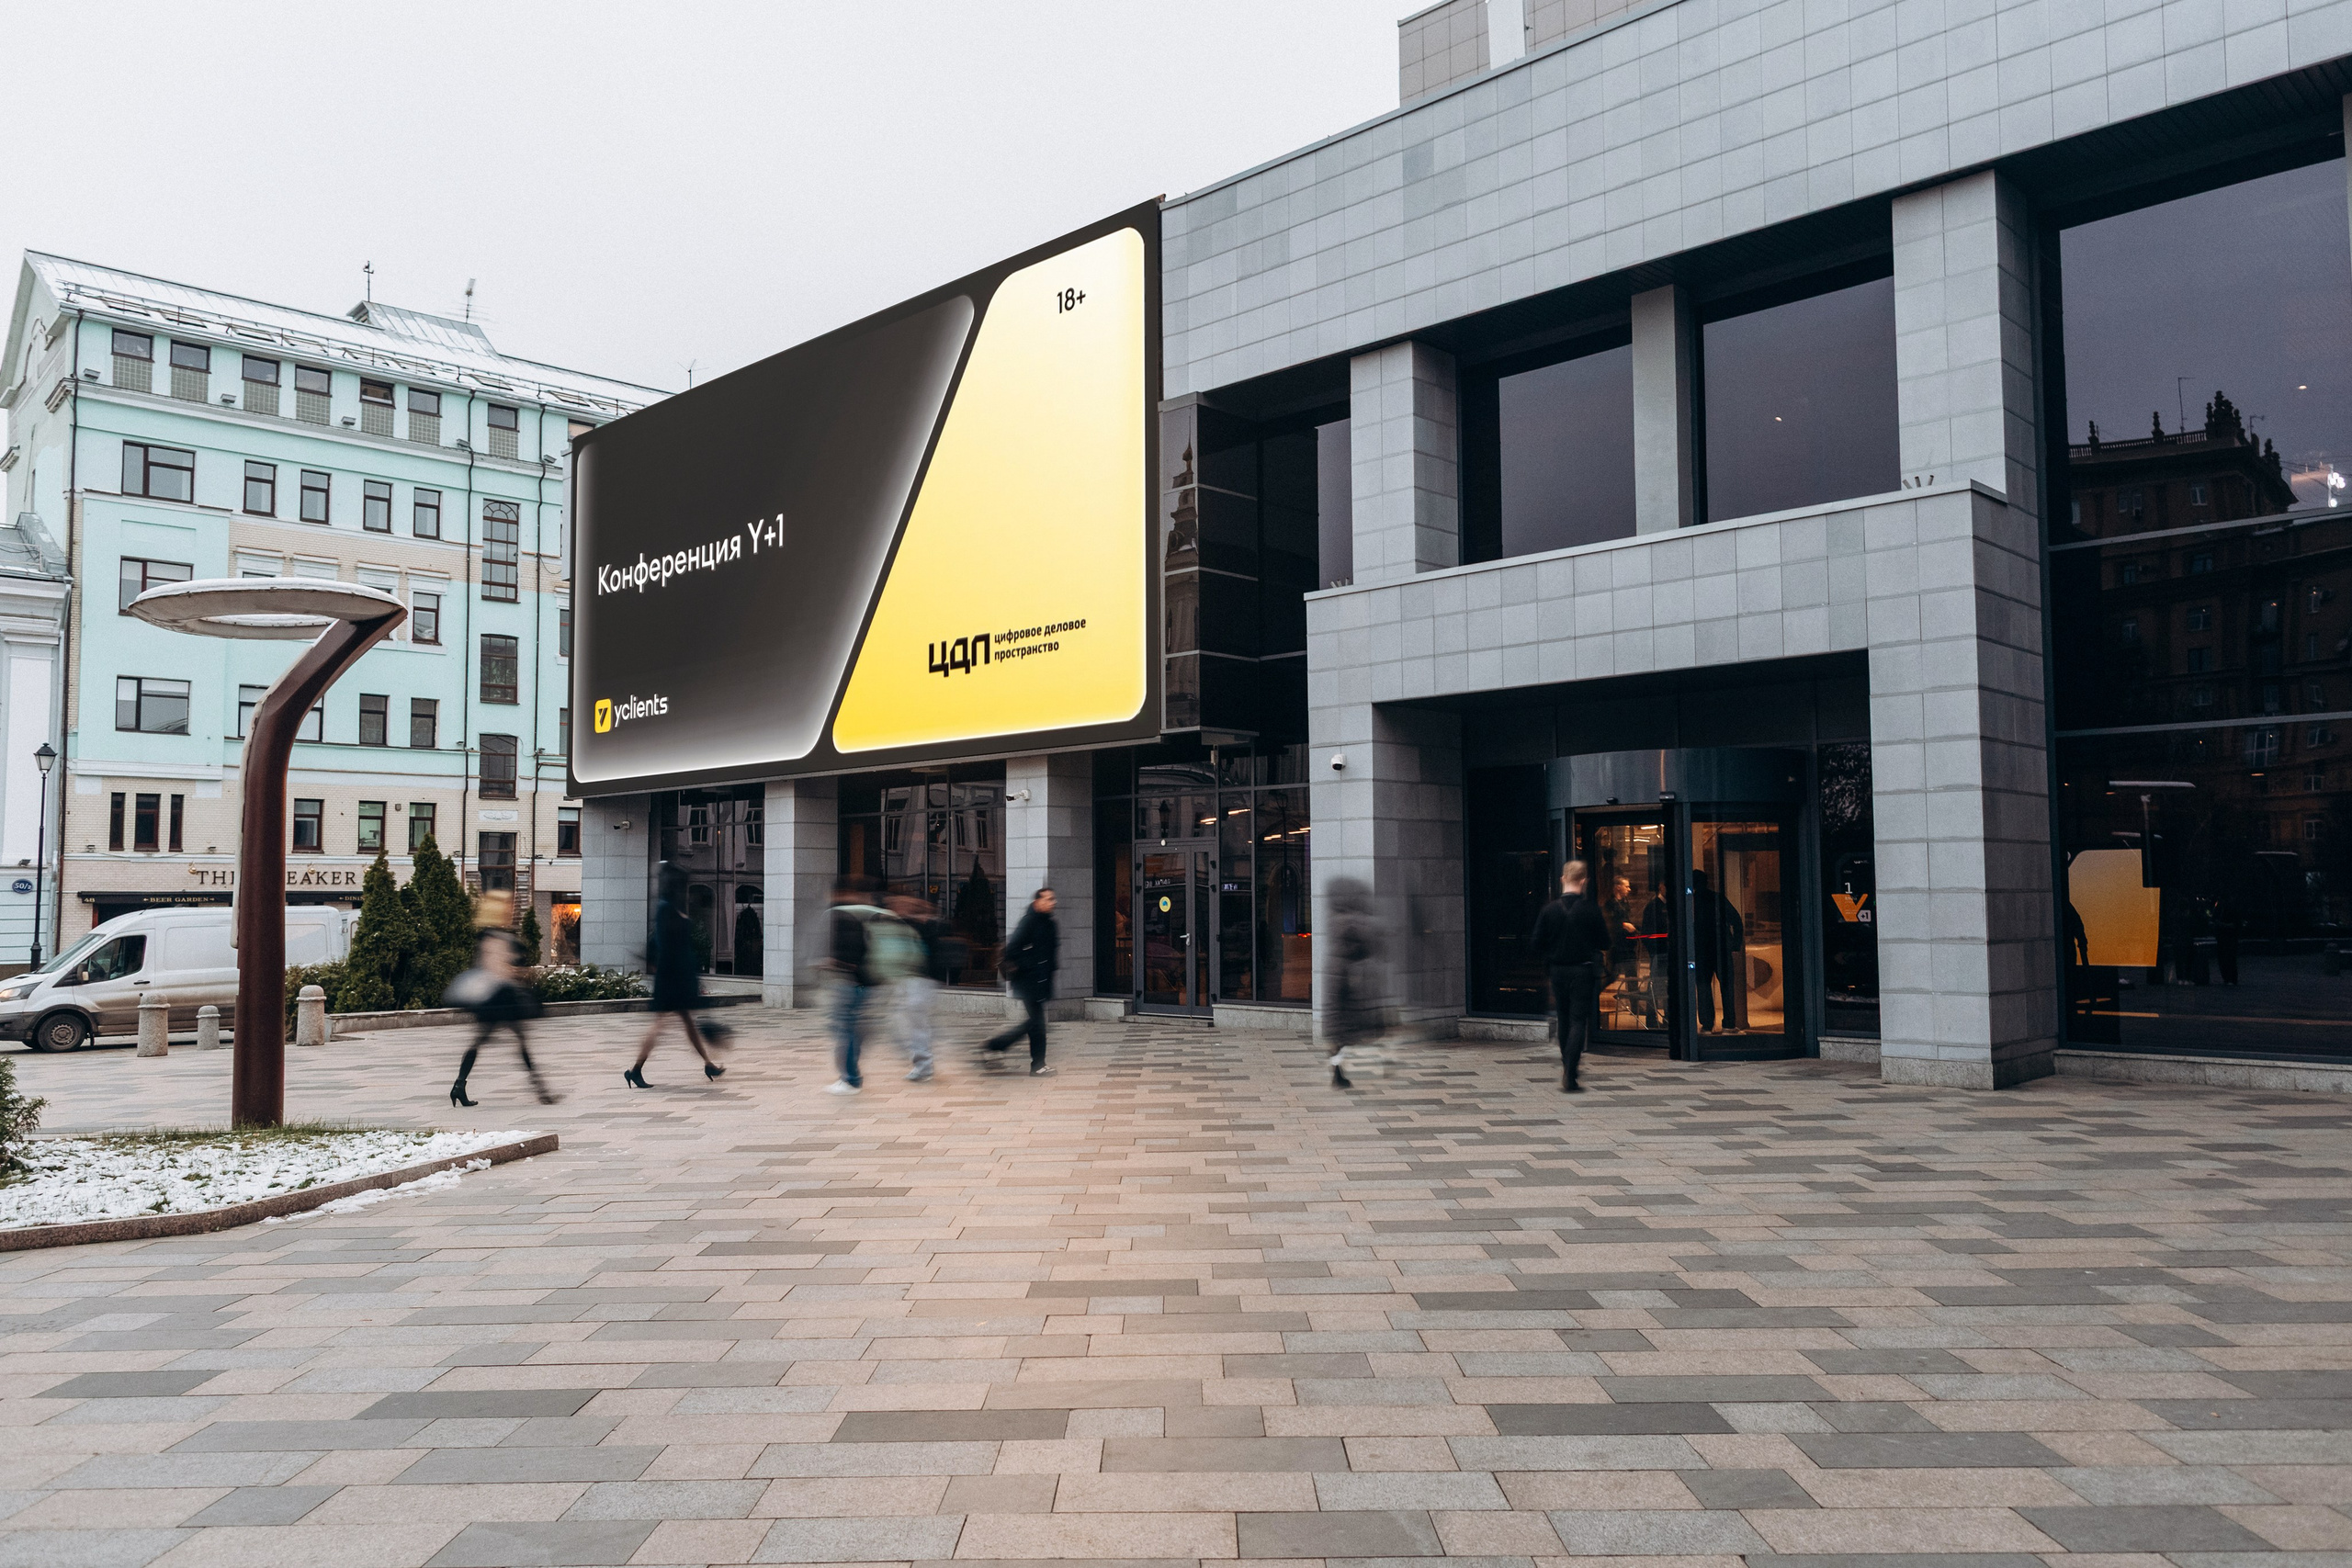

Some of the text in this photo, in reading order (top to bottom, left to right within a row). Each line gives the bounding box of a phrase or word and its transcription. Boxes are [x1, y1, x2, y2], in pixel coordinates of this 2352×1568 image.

[1057, 287, 1087, 314] 18+
[598, 513, 785, 596] Конференция Y+1
[994, 618, 1087, 645] цифровое деловое
[928, 632, 990, 678] ЦДП
[994, 641, 1059, 663] пространство
[614, 694, 669, 728] yclients
[287, 871, 356, 886] EAKER
